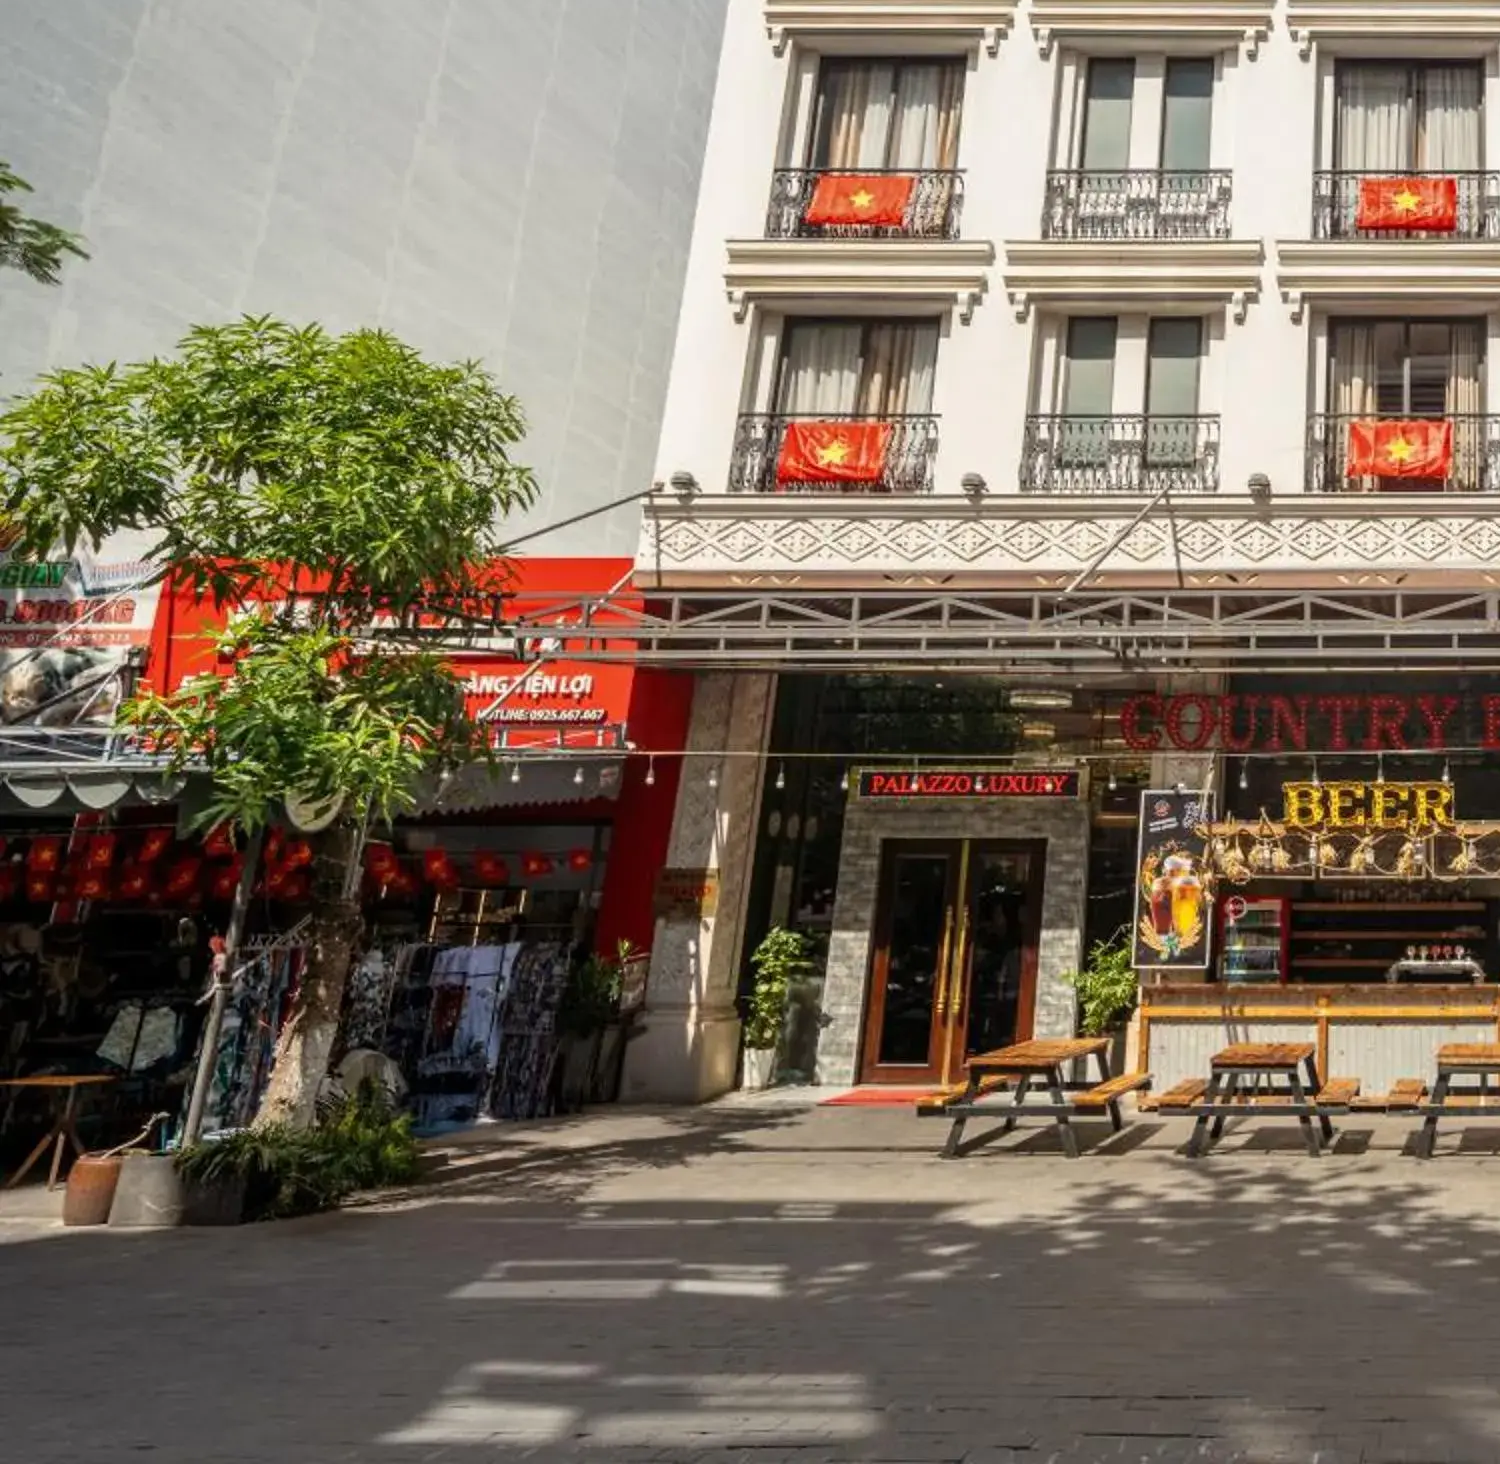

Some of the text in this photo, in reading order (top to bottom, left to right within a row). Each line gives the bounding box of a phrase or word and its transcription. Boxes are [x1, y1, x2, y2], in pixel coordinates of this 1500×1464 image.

[1119, 693, 1460, 751] COUNTRY
[870, 775, 1069, 793] PALAZZO LUXURY
[1282, 782, 1456, 828] BEER
